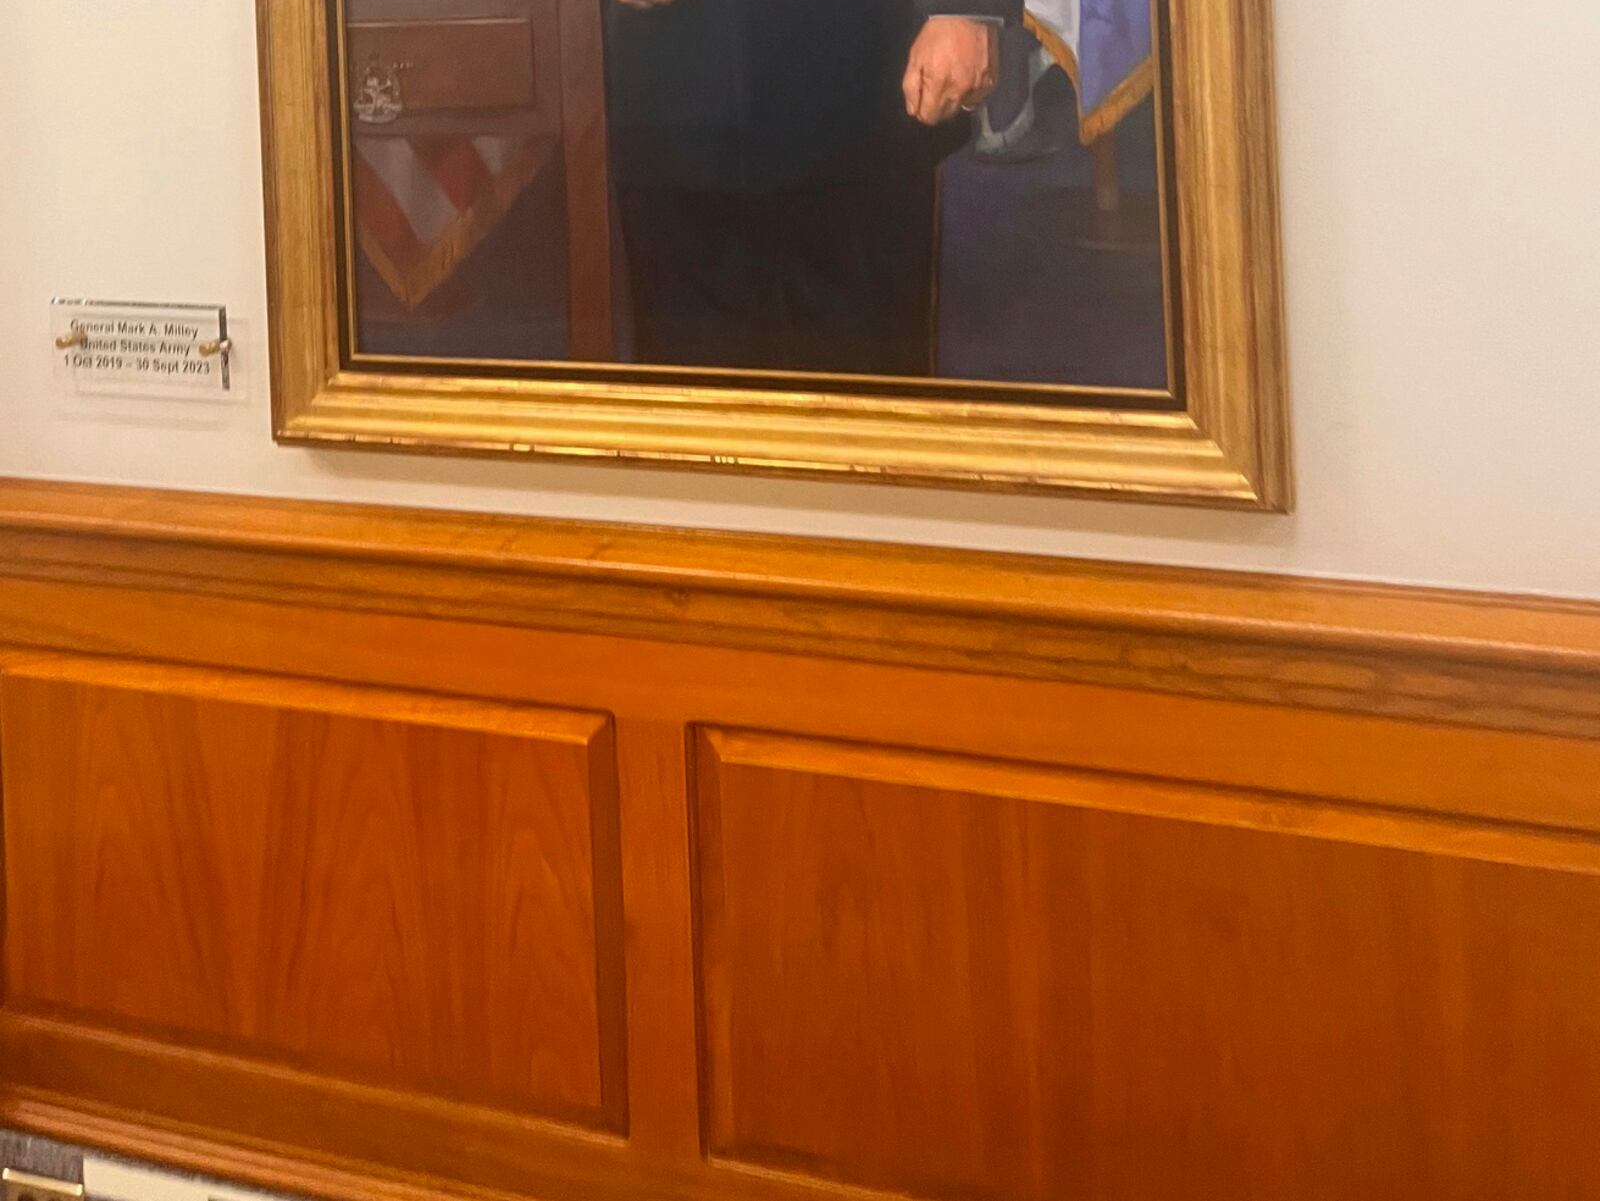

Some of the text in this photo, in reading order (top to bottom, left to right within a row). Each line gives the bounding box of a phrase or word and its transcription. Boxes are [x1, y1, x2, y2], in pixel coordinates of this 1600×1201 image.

[70, 318, 199, 342] General Mark A. Milley
[80, 336, 191, 358] United States Army
[72, 354, 92, 368] Oct
[96, 354, 122, 369] 2019
[136, 357, 150, 371] 30
[152, 357, 179, 375] Sept
[182, 359, 211, 374] 2023
